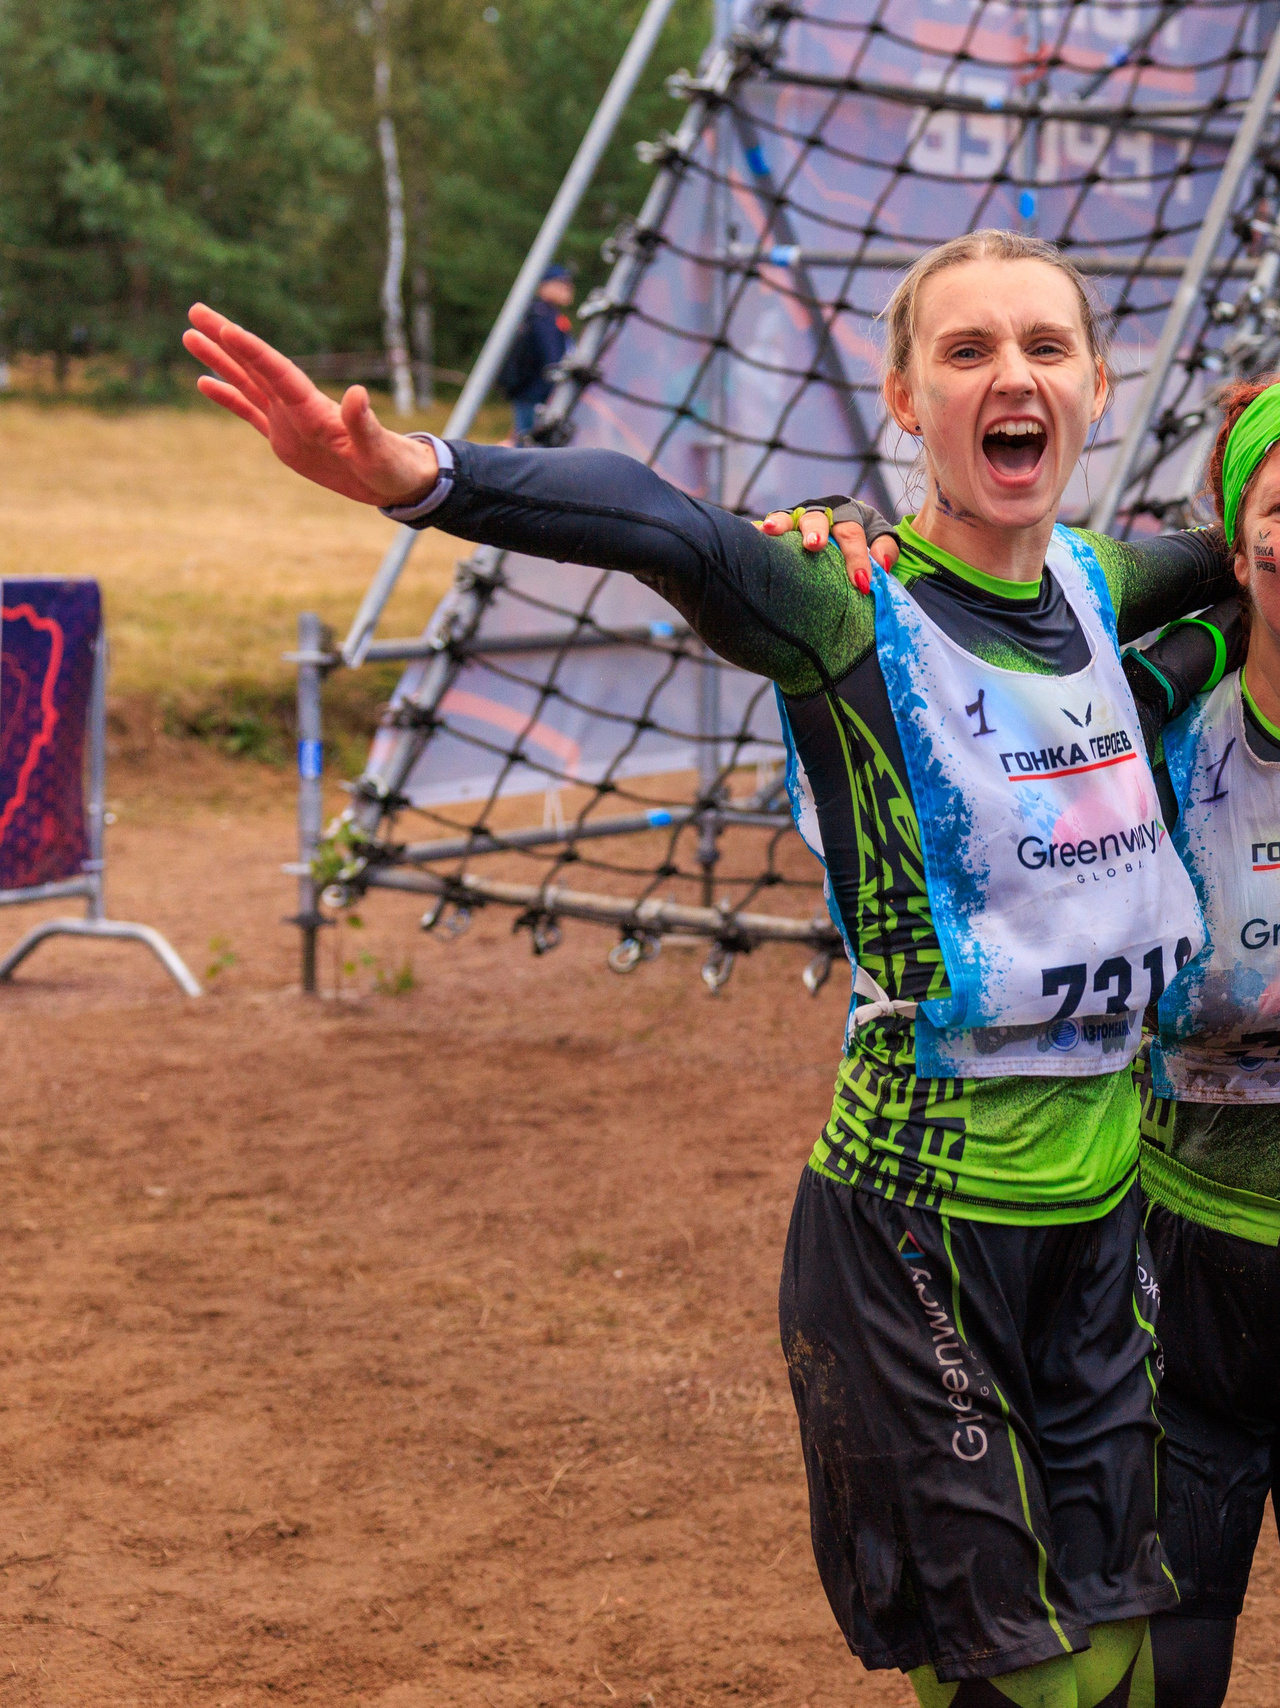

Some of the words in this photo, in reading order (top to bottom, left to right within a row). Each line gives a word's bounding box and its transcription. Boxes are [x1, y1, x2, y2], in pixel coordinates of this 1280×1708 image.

[999, 742, 1089, 773] ГОНКА
[1089, 730, 1133, 760] ГЕРОЕВ
[1076, 859, 1144, 884] GLOB
